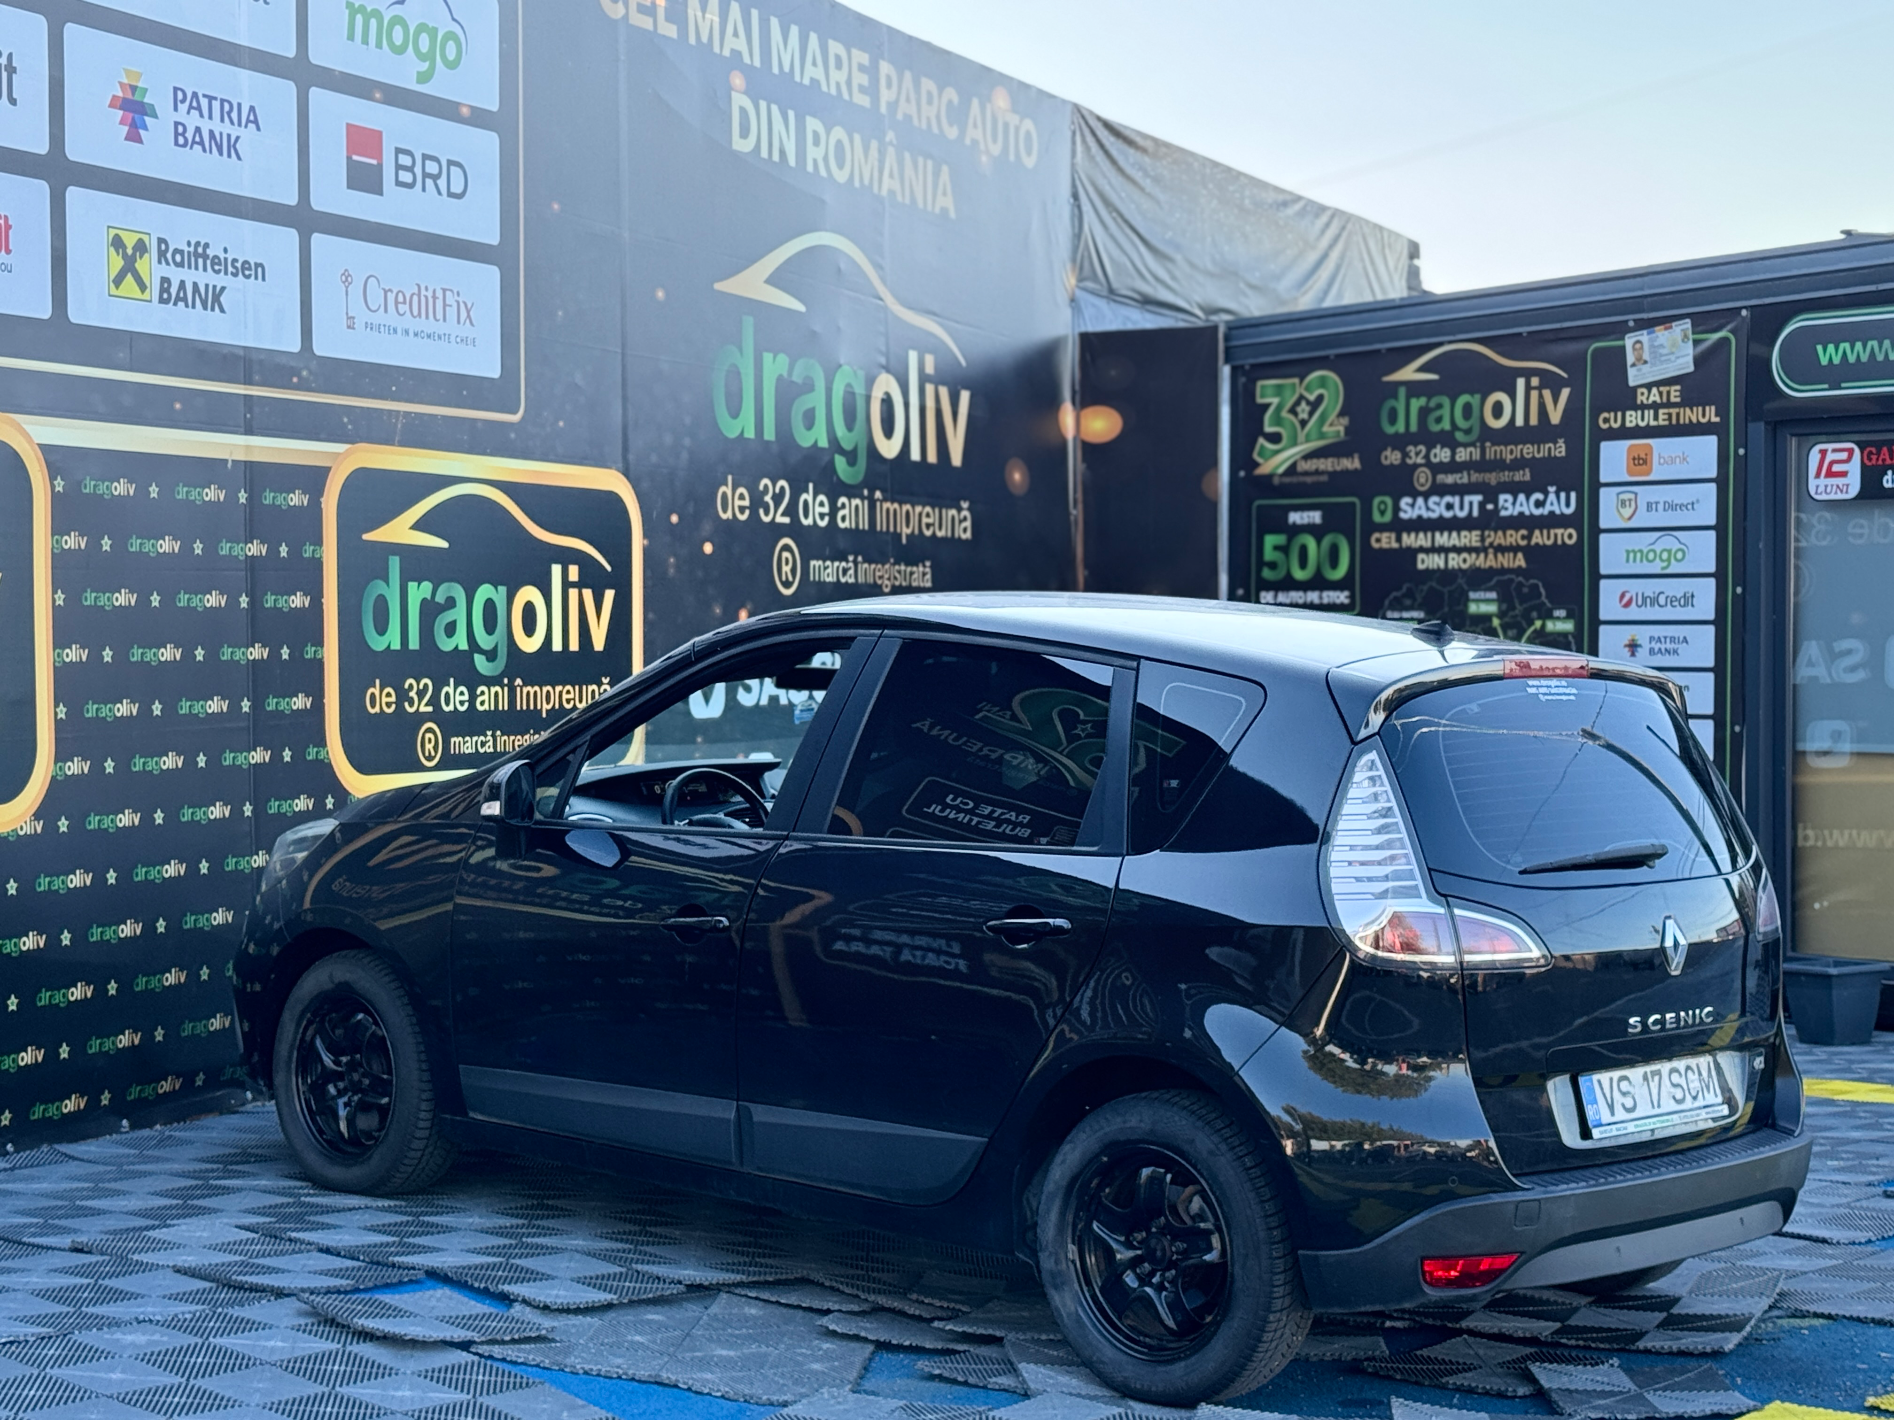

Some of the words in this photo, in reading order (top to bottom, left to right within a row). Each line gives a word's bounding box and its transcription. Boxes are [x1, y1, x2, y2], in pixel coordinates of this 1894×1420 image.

[345, 0, 463, 84] mogo
[688, 0, 760, 68] MAI
[770, 15, 870, 109] MARE
[879, 59, 960, 140] PARC
[965, 96, 1038, 169] AUTO
[172, 85, 261, 132] PATRIA
[173, 121, 243, 161] BANK
[731, 90, 796, 167] DIN
[806, 115, 956, 219] ROMÂNIA
[394, 146, 469, 200] BRD
[157, 237, 266, 282] Raiffeisen
[157, 276, 226, 314] BANK
[362, 274, 476, 328] CreditFix
[364, 321, 398, 336] PRIETEN
[401, 326, 410, 338] IN
[413, 328, 452, 344] MOMENTE
[454, 334, 477, 347] CHEIE
[713, 314, 971, 485] dragoliv
[1380, 376, 1571, 443] dragoliv
[1636, 385, 1681, 405] RATE
[1253, 370, 1344, 463] 32
[1598, 411, 1622, 429] CU
[1625, 405, 1720, 428] BULETINUL
[1380, 447, 1401, 465] de
[1405, 445, 1426, 463] 32
[1430, 443, 1451, 462] de
[1455, 443, 1481, 461] ani
[1485, 438, 1565, 462] împreună
[1631, 453, 1648, 467] tbi
[1658, 452, 1690, 467] bank
[1814, 447, 1855, 479] 12
[1863, 446, 1894, 466] GA
[1436, 470, 1469, 484] marcă
[1470, 468, 1531, 485] înregistrată
[1814, 483, 1850, 495] LUNI
[81, 476, 136, 499] dragoliv
[174, 483, 226, 505] dragoliv
[262, 489, 310, 510] dragoliv
[1399, 494, 1484, 519] SASCUT
[1497, 485, 1577, 516] BACĂU
[1620, 498, 1633, 509] BT
[1646, 501, 1660, 513] BT
[715, 475, 750, 522] de
[759, 478, 790, 524] 32
[798, 482, 829, 527] de
[836, 488, 869, 531] ani
[875, 490, 973, 544] împreună
[1287, 510, 1323, 525] PESTE
[52, 531, 88, 553] goliv
[128, 535, 181, 557] dragoliv
[218, 538, 268, 560] dragoliv
[1370, 532, 1400, 549] CEL
[1401, 531, 1432, 549] MAI
[1434, 530, 1481, 548] MARE
[1484, 529, 1528, 546] PARC
[1530, 528, 1578, 546] AUTO
[1261, 532, 1351, 582] 500
[1416, 553, 1445, 570] DIN
[1447, 548, 1527, 570] ROMÂNIA
[1625, 547, 1687, 571] mogo
[809, 555, 856, 584] marcă
[857, 556, 933, 593] înregistrată
[82, 588, 137, 610] dragoliv
[176, 590, 227, 611] dragoliv
[263, 591, 311, 611] dragoliv
[1259, 590, 1276, 604] DE
[1276, 590, 1305, 605] AUTO
[1306, 590, 1320, 605] PE
[1321, 589, 1351, 605] STOC
[1635, 591, 1695, 608] UniCredit
[361, 555, 615, 676] dragoliv
[53, 644, 88, 667] goliv
[129, 644, 182, 665] dragoliv
[219, 643, 269, 664] dragoliv
[1648, 646, 1680, 657] BANK
[1649, 635, 1689, 646] PATRIA
[83, 699, 139, 721] dragoliv
[177, 696, 229, 717] dragoliv
[265, 693, 312, 713] dragoliv
[365, 679, 396, 714] de
[404, 678, 433, 713] 32
[441, 677, 469, 712] de
[476, 677, 509, 711] ani
[450, 731, 494, 754] marcă
[131, 752, 184, 774] dragoliv
[221, 747, 271, 769] dragoliv
[85, 809, 141, 832] dragoliv
[180, 801, 231, 824] dragoliv
[267, 794, 314, 816] dragoliv
[35, 868, 93, 893] dragoliv
[133, 860, 187, 883] dragoliv
[88, 918, 143, 943] dragoliv
[182, 907, 234, 930] dragoliv
[36, 981, 94, 1007] dragoliv
[133, 967, 187, 992] dragoliv
[87, 1028, 142, 1054] dragoliv
[180, 1013, 232, 1037] dragoliv
[1627, 1006, 1714, 1034] SCENIC
[1587, 1105, 1600, 1120] RO
[1597, 1075, 1637, 1117] VS
[1642, 1068, 1662, 1110] 17
[1668, 1060, 1718, 1105] SCM
[29, 1093, 88, 1120] dragoliv
